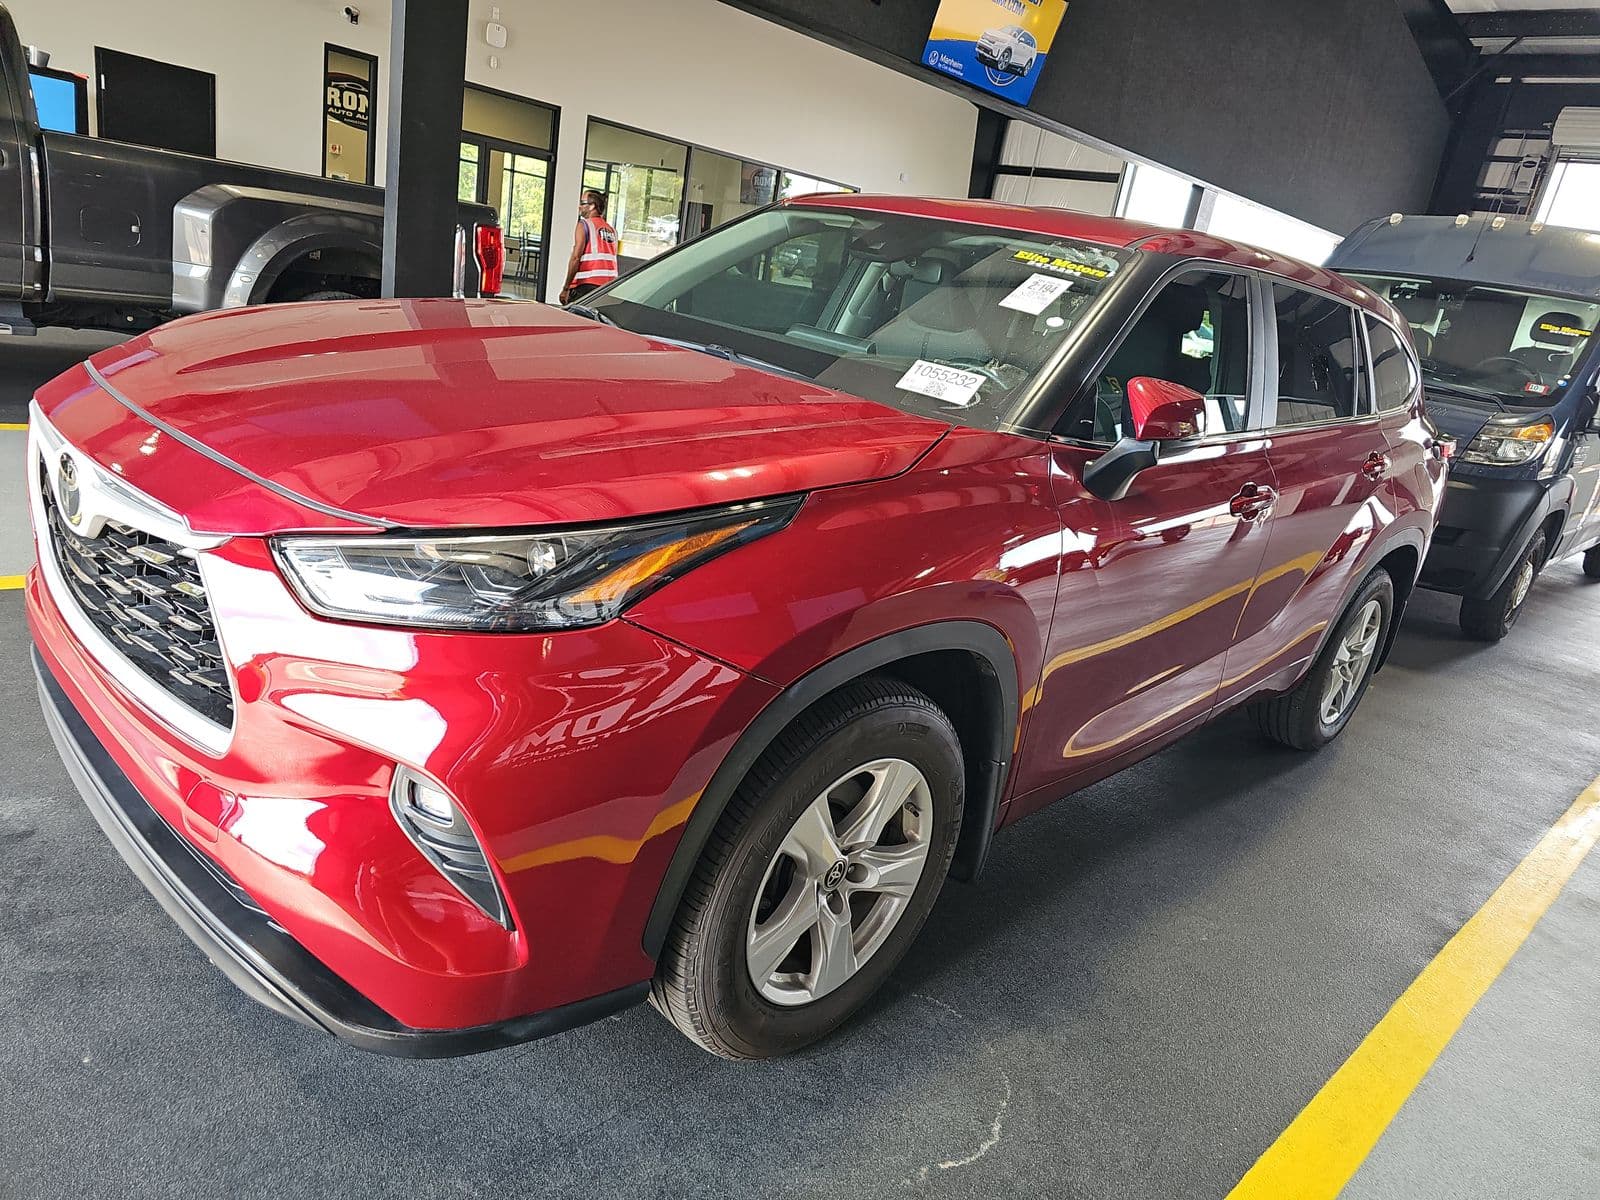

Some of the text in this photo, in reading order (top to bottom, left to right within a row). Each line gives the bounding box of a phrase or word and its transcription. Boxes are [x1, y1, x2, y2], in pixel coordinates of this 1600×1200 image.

[328, 107, 353, 117] AUTO
[1014, 250, 1051, 264] Elite
[1051, 257, 1108, 278] Motors
[914, 364, 978, 389] 1055232
